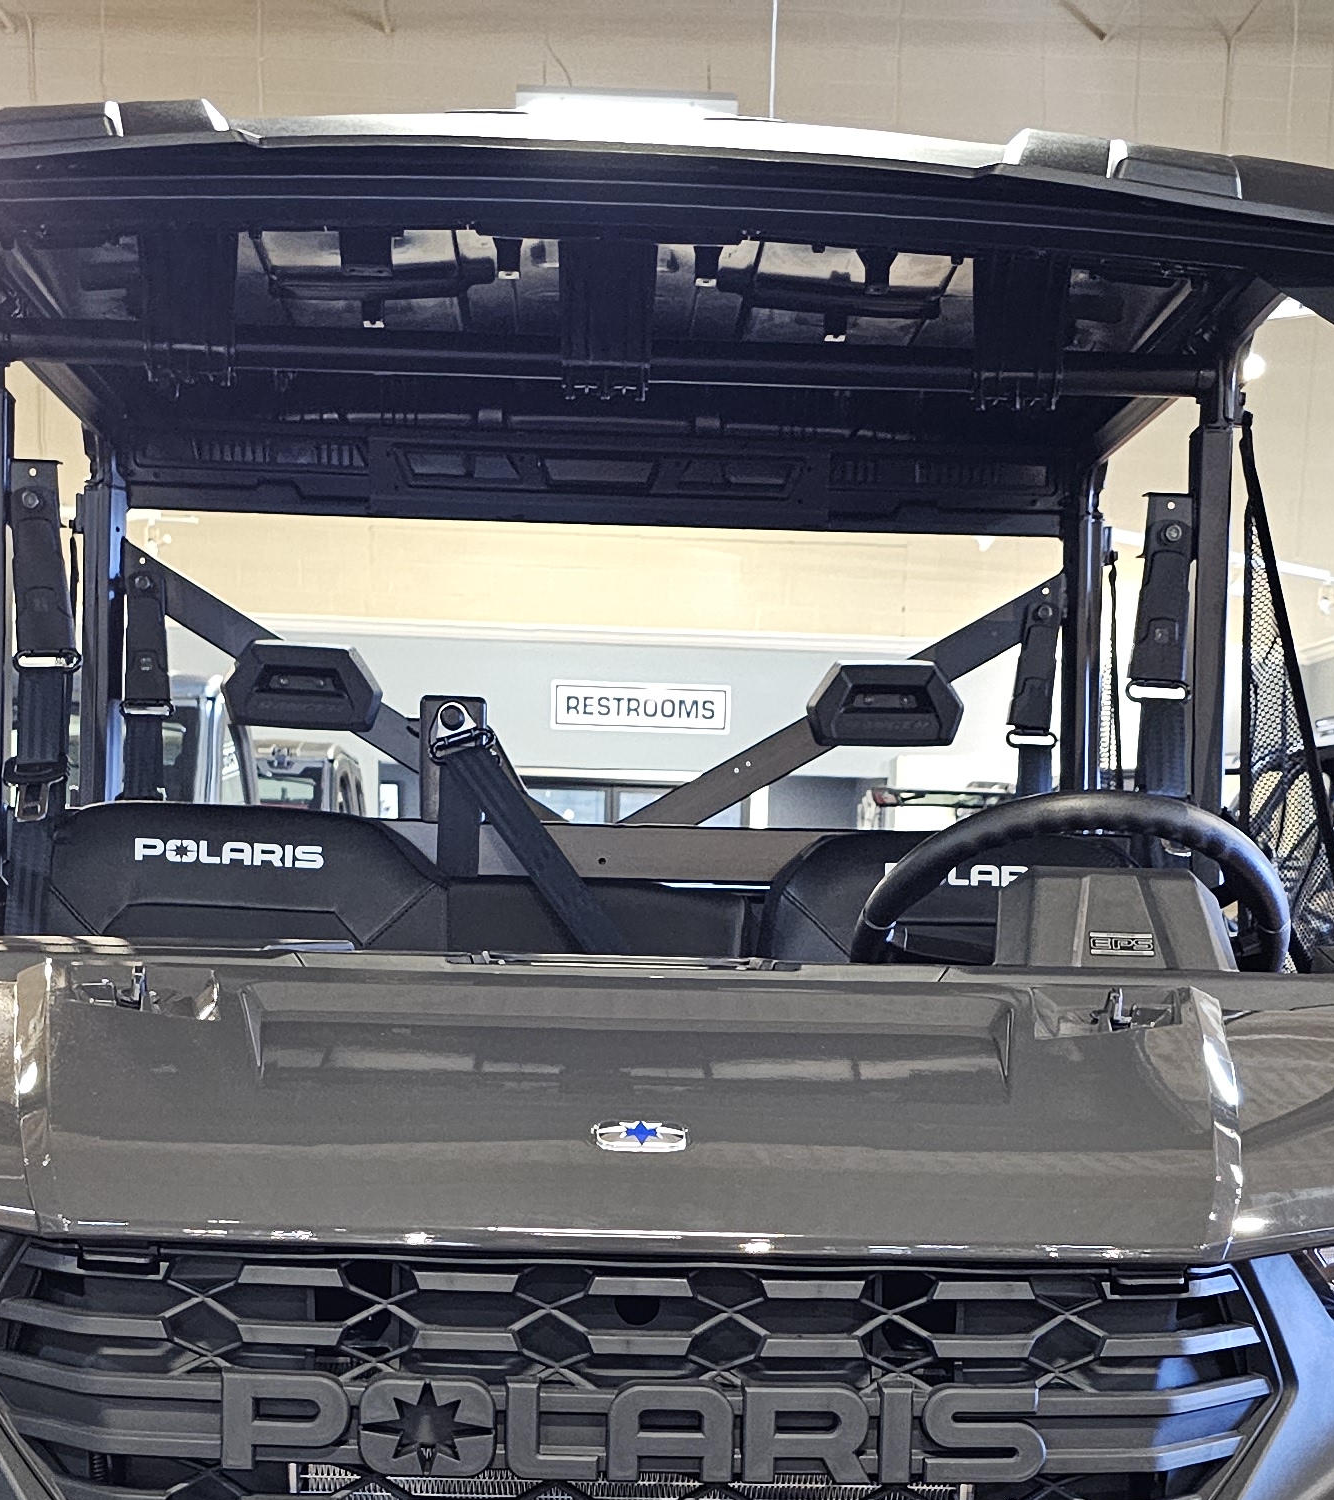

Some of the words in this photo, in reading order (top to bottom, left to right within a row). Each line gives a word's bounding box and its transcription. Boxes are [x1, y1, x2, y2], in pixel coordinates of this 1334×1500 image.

[566, 695, 715, 720] RESTROOMS
[134, 837, 324, 869] POLARIS
[1090, 938, 1154, 951] EPS
[221, 1369, 1048, 1485] POLARIS
